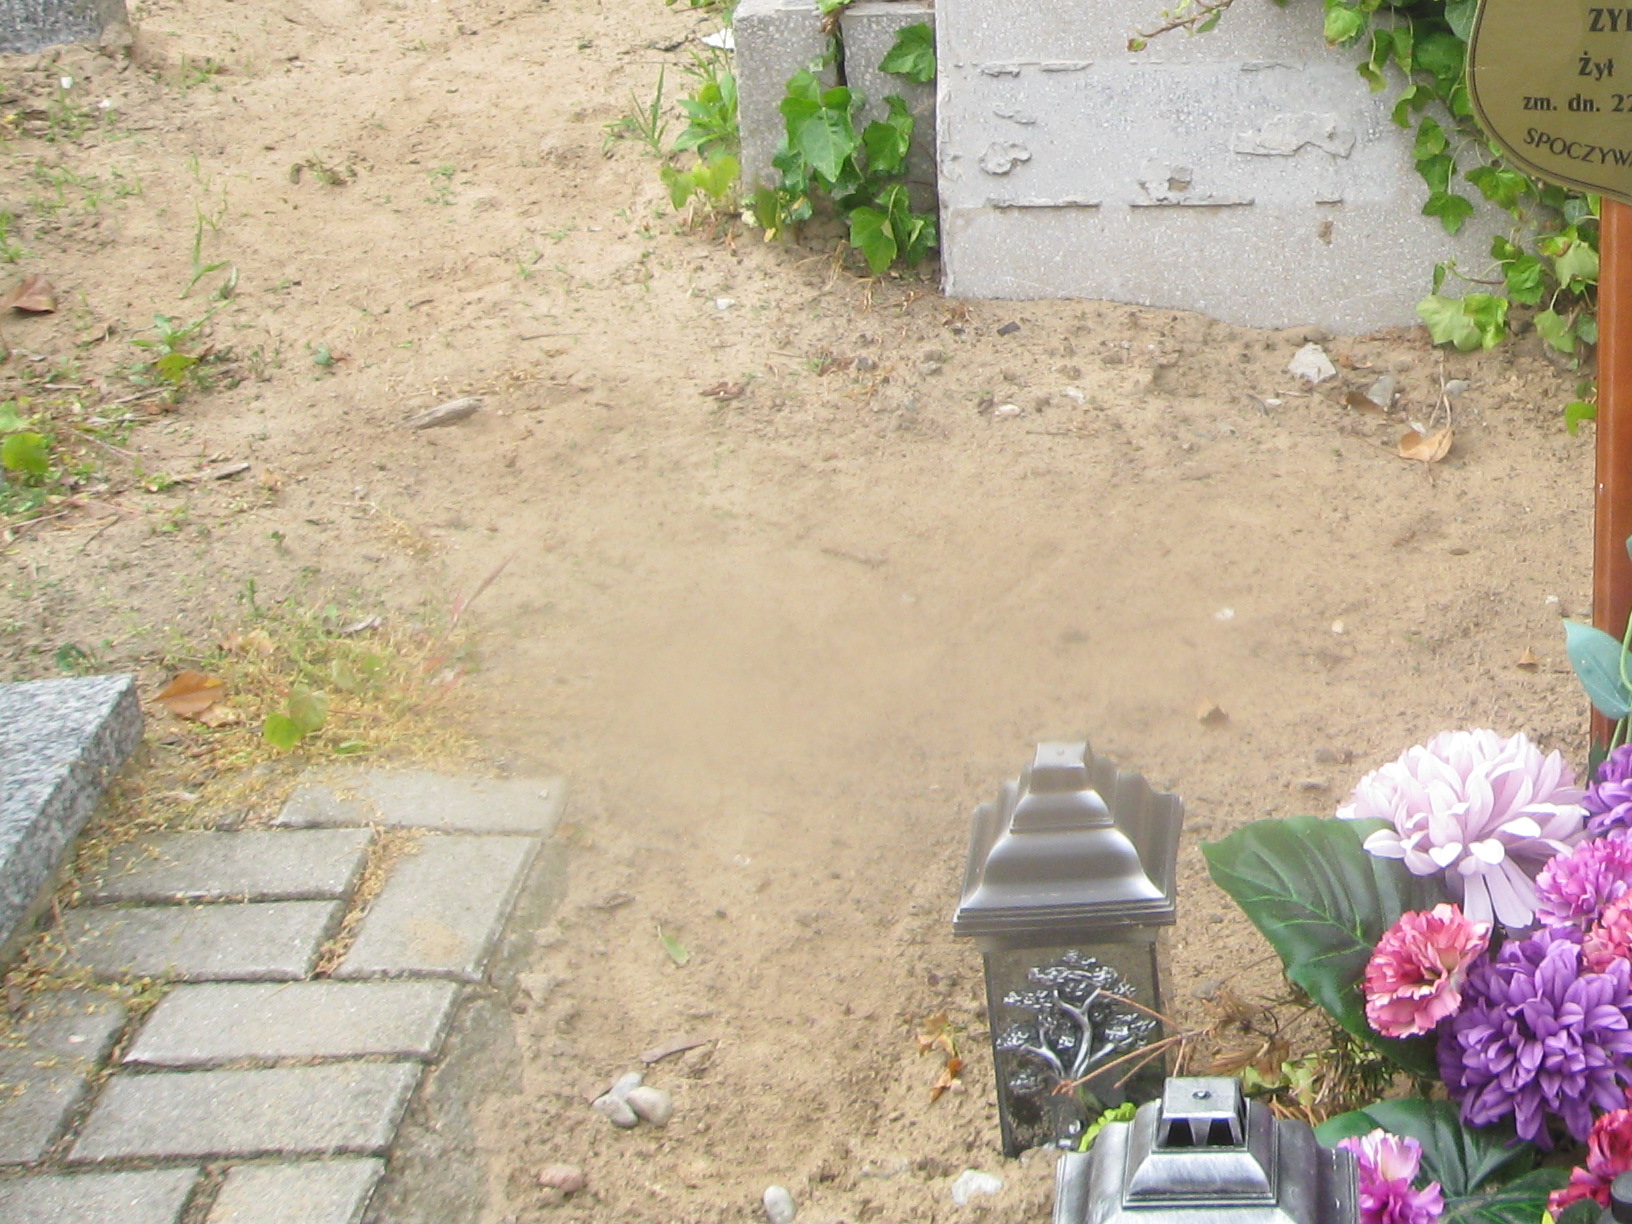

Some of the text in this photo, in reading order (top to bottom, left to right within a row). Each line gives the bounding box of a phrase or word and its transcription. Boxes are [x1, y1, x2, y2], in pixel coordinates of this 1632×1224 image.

[1578, 50, 1614, 82] Żył
[1522, 95, 1558, 112] zm.
[1567, 93, 1601, 113] dn.
